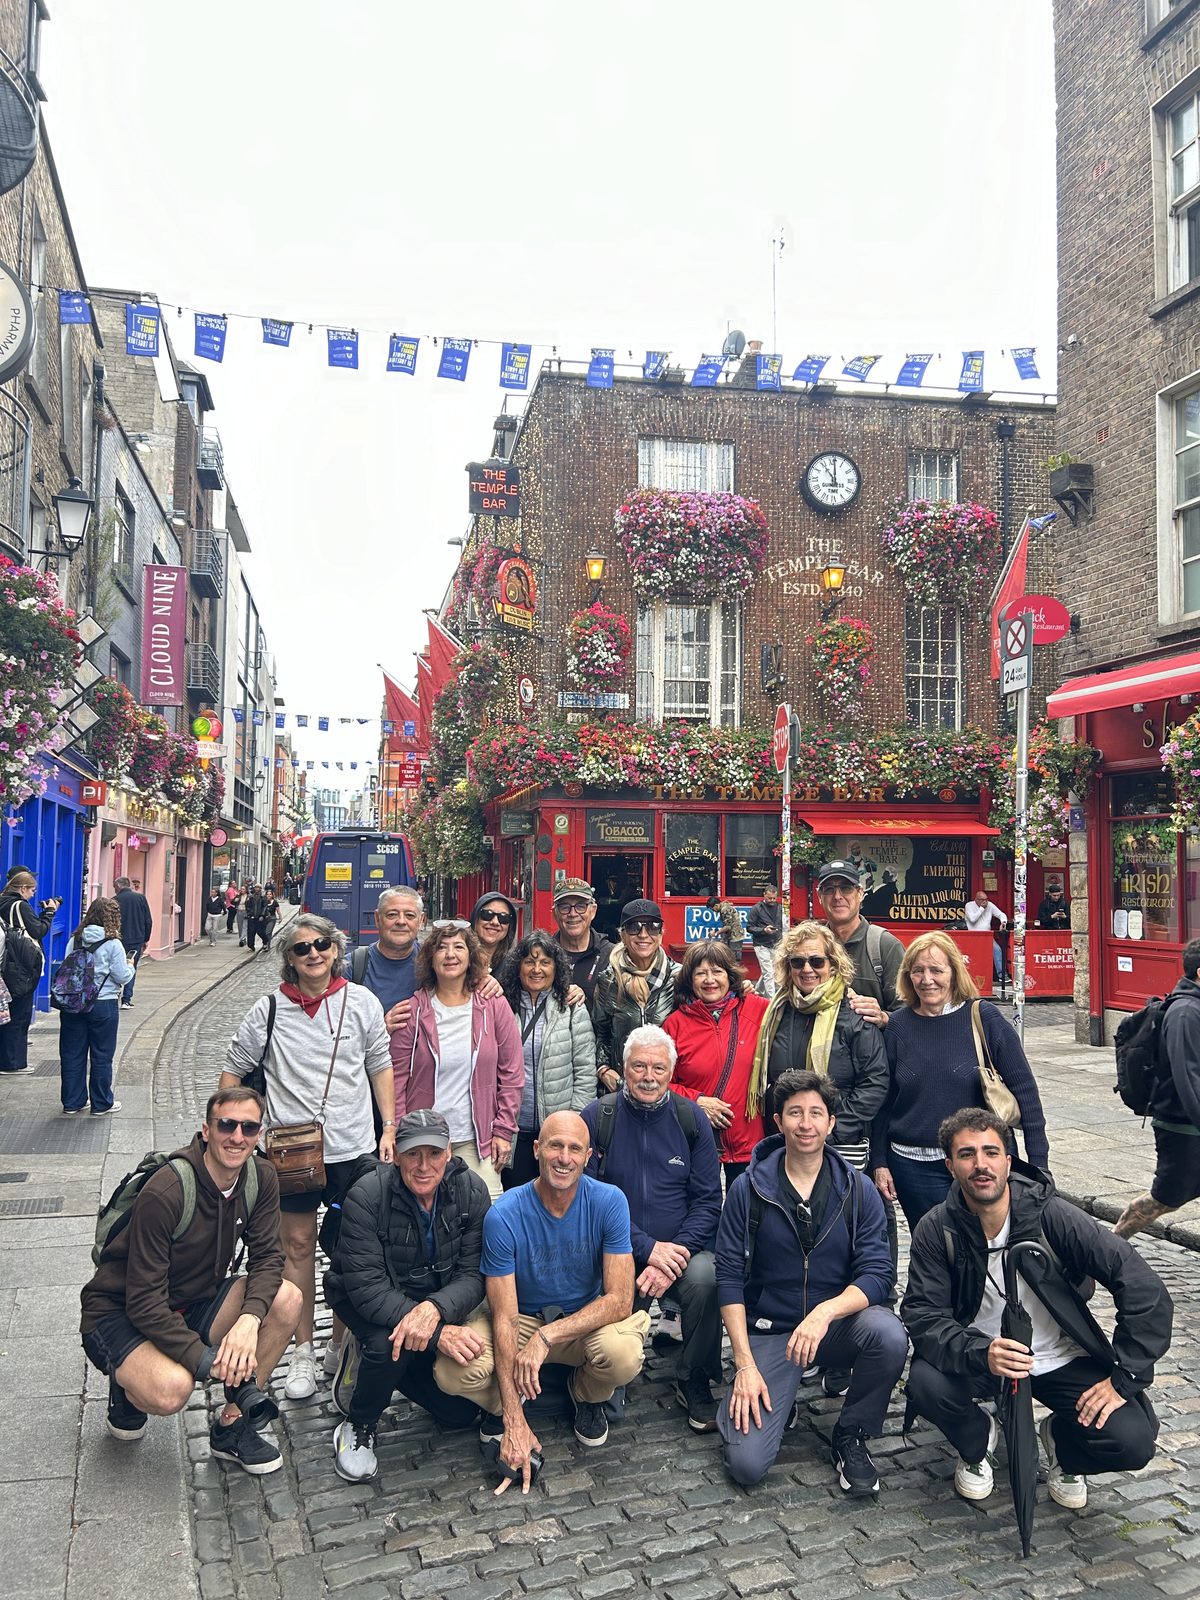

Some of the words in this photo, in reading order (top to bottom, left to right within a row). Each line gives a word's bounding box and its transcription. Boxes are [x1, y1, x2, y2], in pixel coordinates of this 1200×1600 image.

[482, 469, 507, 481] THE
[471, 482, 518, 496] TEMPLE
[482, 498, 507, 509] BAR
[806, 537, 843, 553] THE
[763, 555, 827, 582] TEMPL
[846, 561, 884, 588] BAR
[152, 571, 178, 616] NINE
[150, 623, 175, 686] CLOUD
[1005, 668, 1015, 684] 24
[1015, 673, 1026, 681] HOUR
[774, 726, 788, 751] STOP
[82, 786, 101, 800] PI
[651, 784, 705, 800] THE
[833, 786, 886, 802] BAR
[376, 844, 399, 854] SC636
[880, 839, 898, 847] THE
[668, 846, 700, 862] TEMPLE
[702, 848, 719, 864] BAR
[869, 847, 907, 856] TEMPLE
[879, 855, 898, 864] BAR
[946, 854, 965, 865] THE
[923, 865, 966, 877] EMPEROR
[954, 878, 965, 889] OF
[893, 893, 929, 906] MALTED
[931, 889, 967, 904] LIQUORS
[692, 909, 748, 922] POWR
[889, 906, 965, 919] GUINNESS
[1033, 954, 1073, 963] TEMPLE
